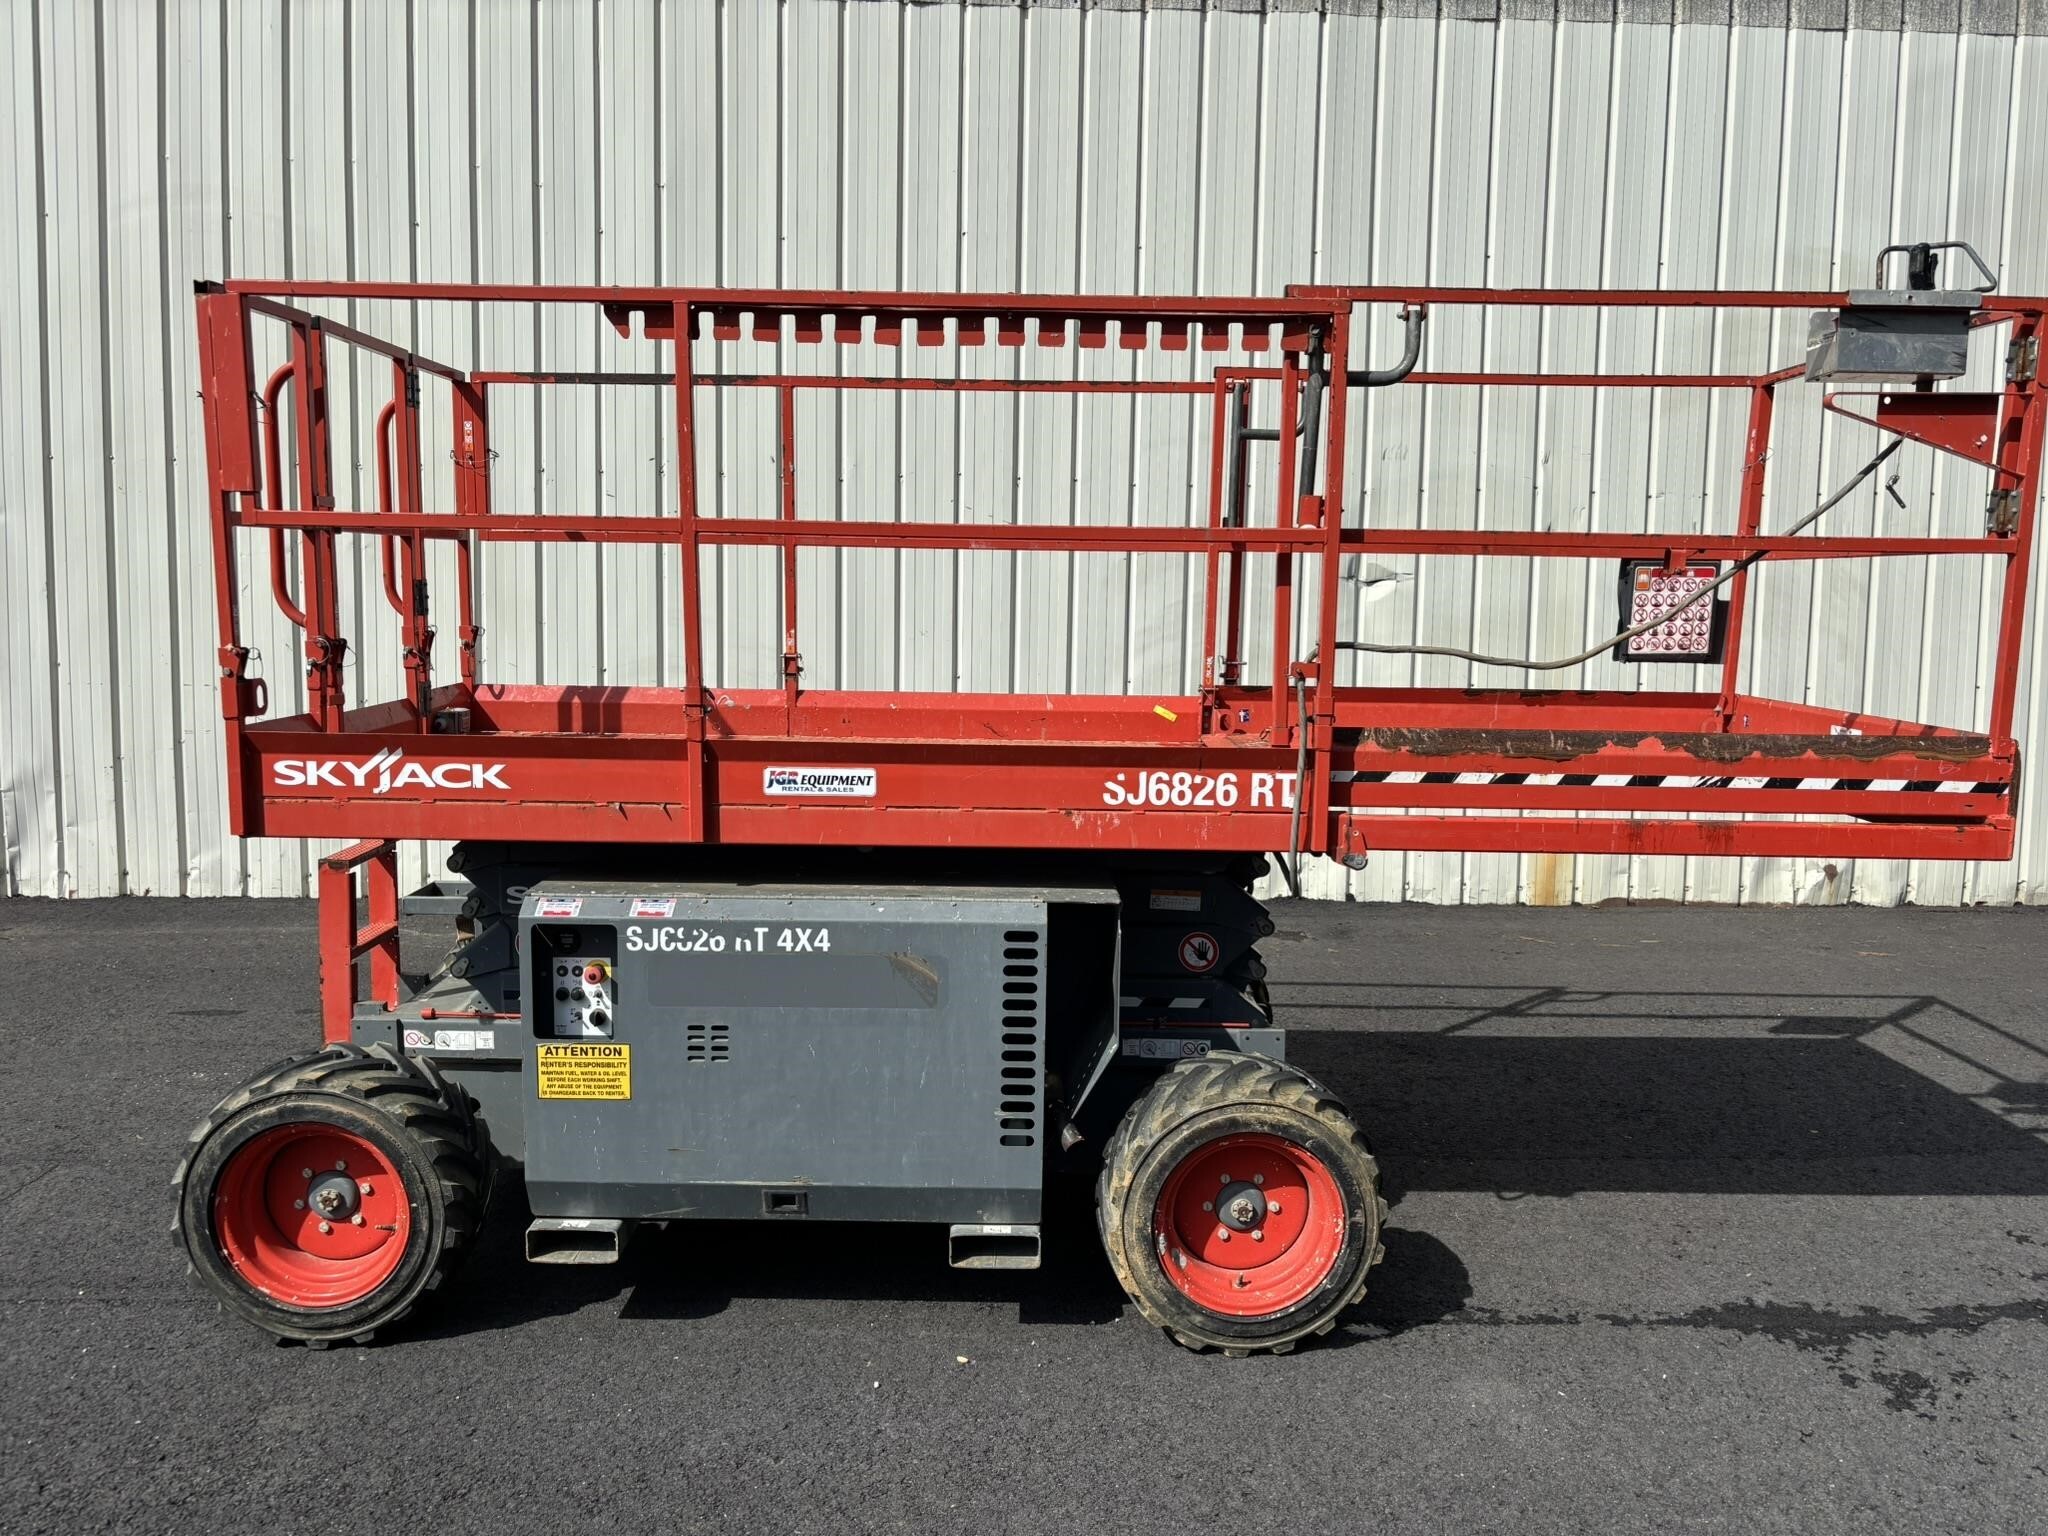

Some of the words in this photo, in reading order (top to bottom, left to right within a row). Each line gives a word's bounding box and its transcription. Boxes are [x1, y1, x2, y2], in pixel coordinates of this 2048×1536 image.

[273, 747, 512, 794] SKYJACK
[767, 770, 799, 788] JGR
[800, 774, 874, 788] EQUIPMENT
[1102, 771, 1239, 807] SJ6826
[1250, 772, 1297, 808] RT
[776, 928, 831, 953] 4X4
[545, 1046, 623, 1057] ATTENTION
